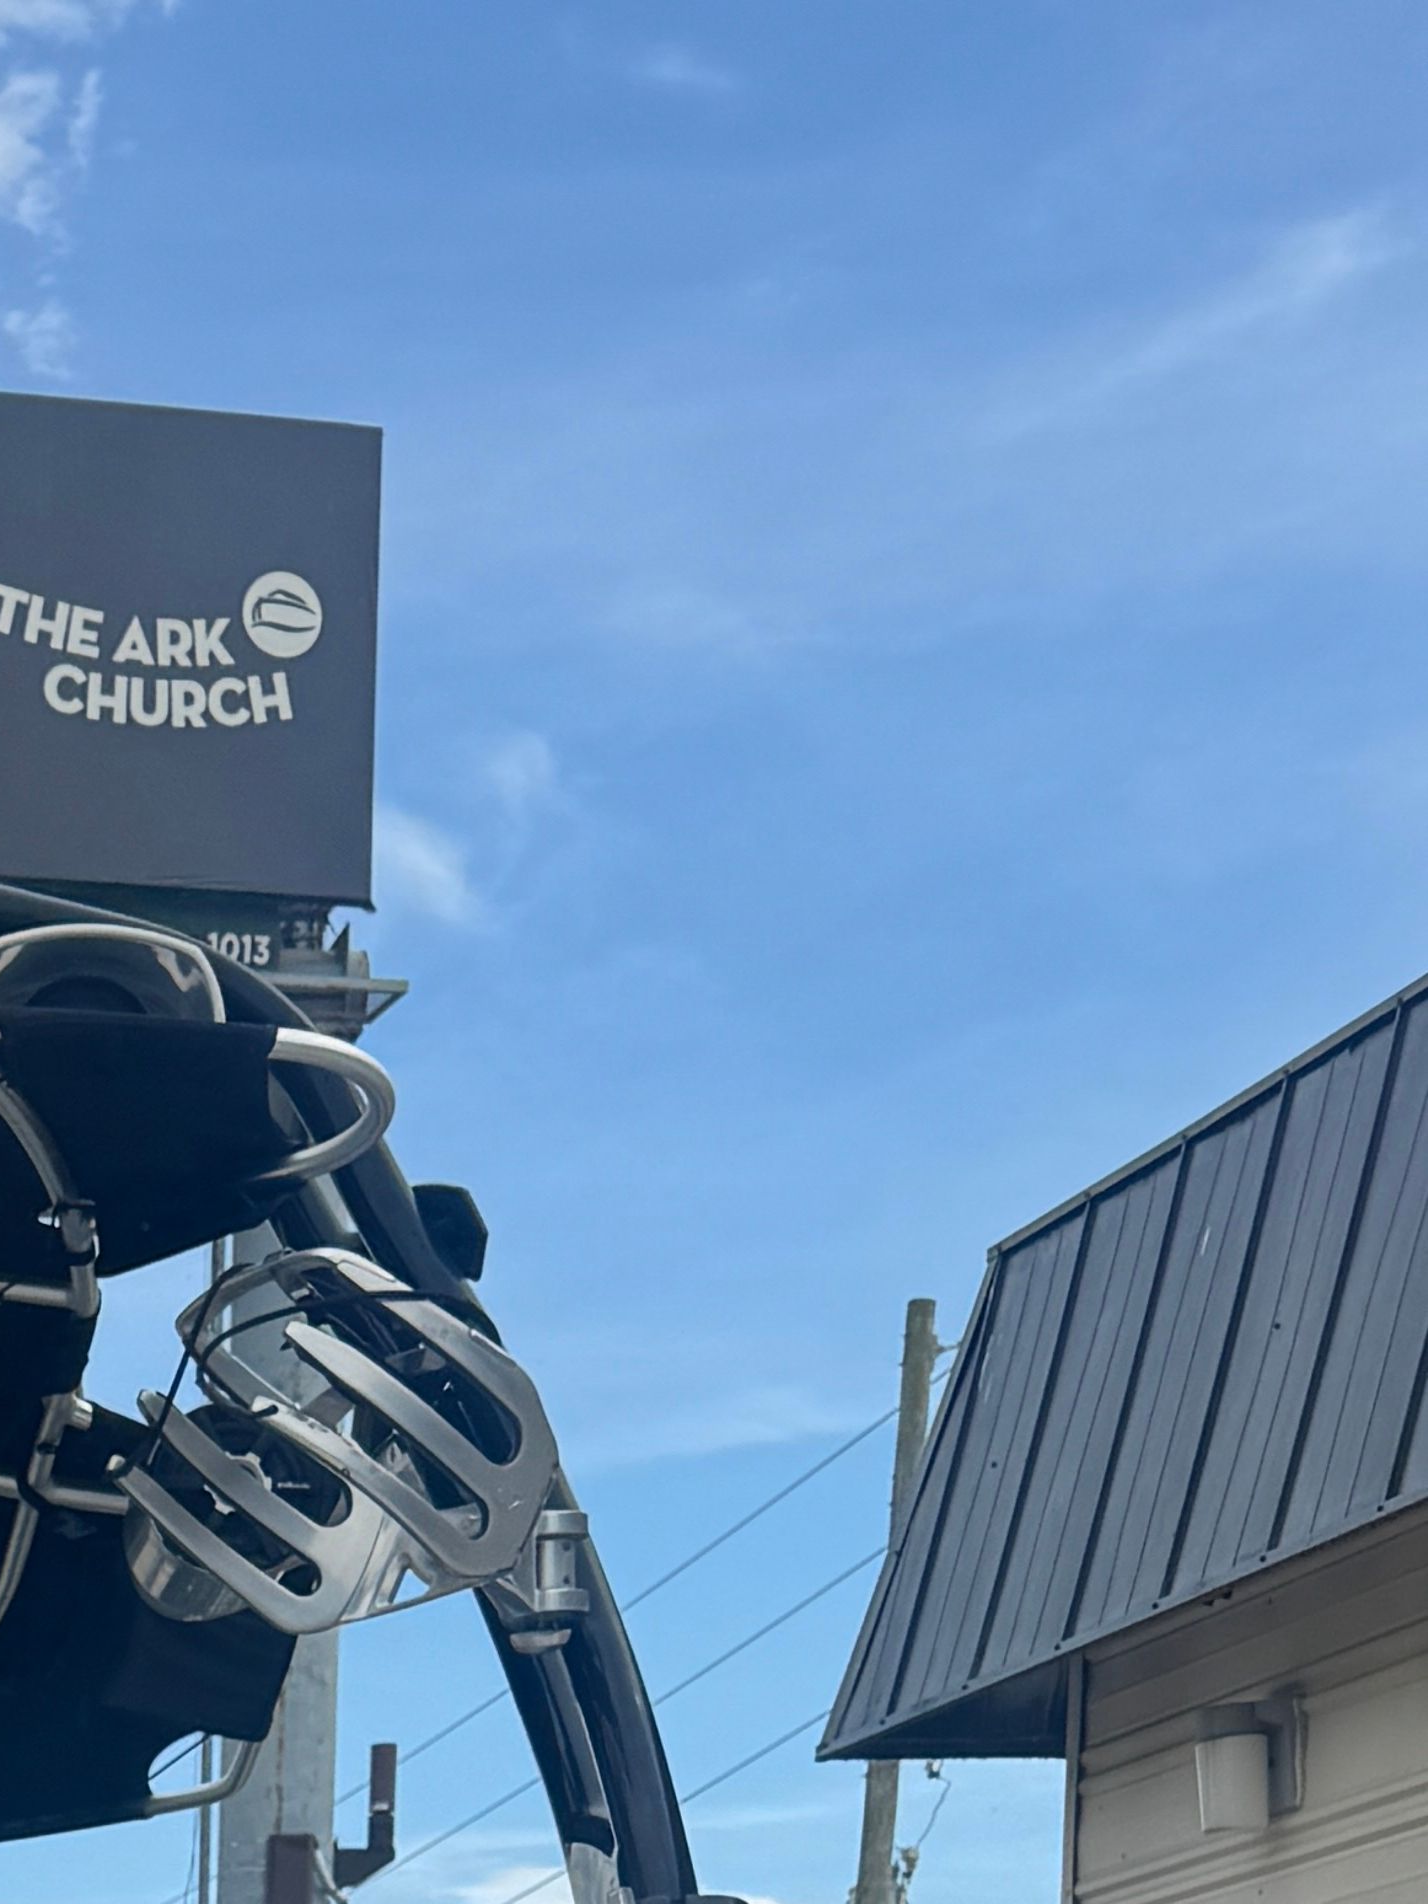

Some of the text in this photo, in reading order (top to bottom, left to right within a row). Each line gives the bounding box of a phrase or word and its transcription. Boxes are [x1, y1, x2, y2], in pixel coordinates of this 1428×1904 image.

[113, 616, 235, 668] ARK
[44, 664, 293, 728] CHURCH
[207, 931, 271, 966] 1013
